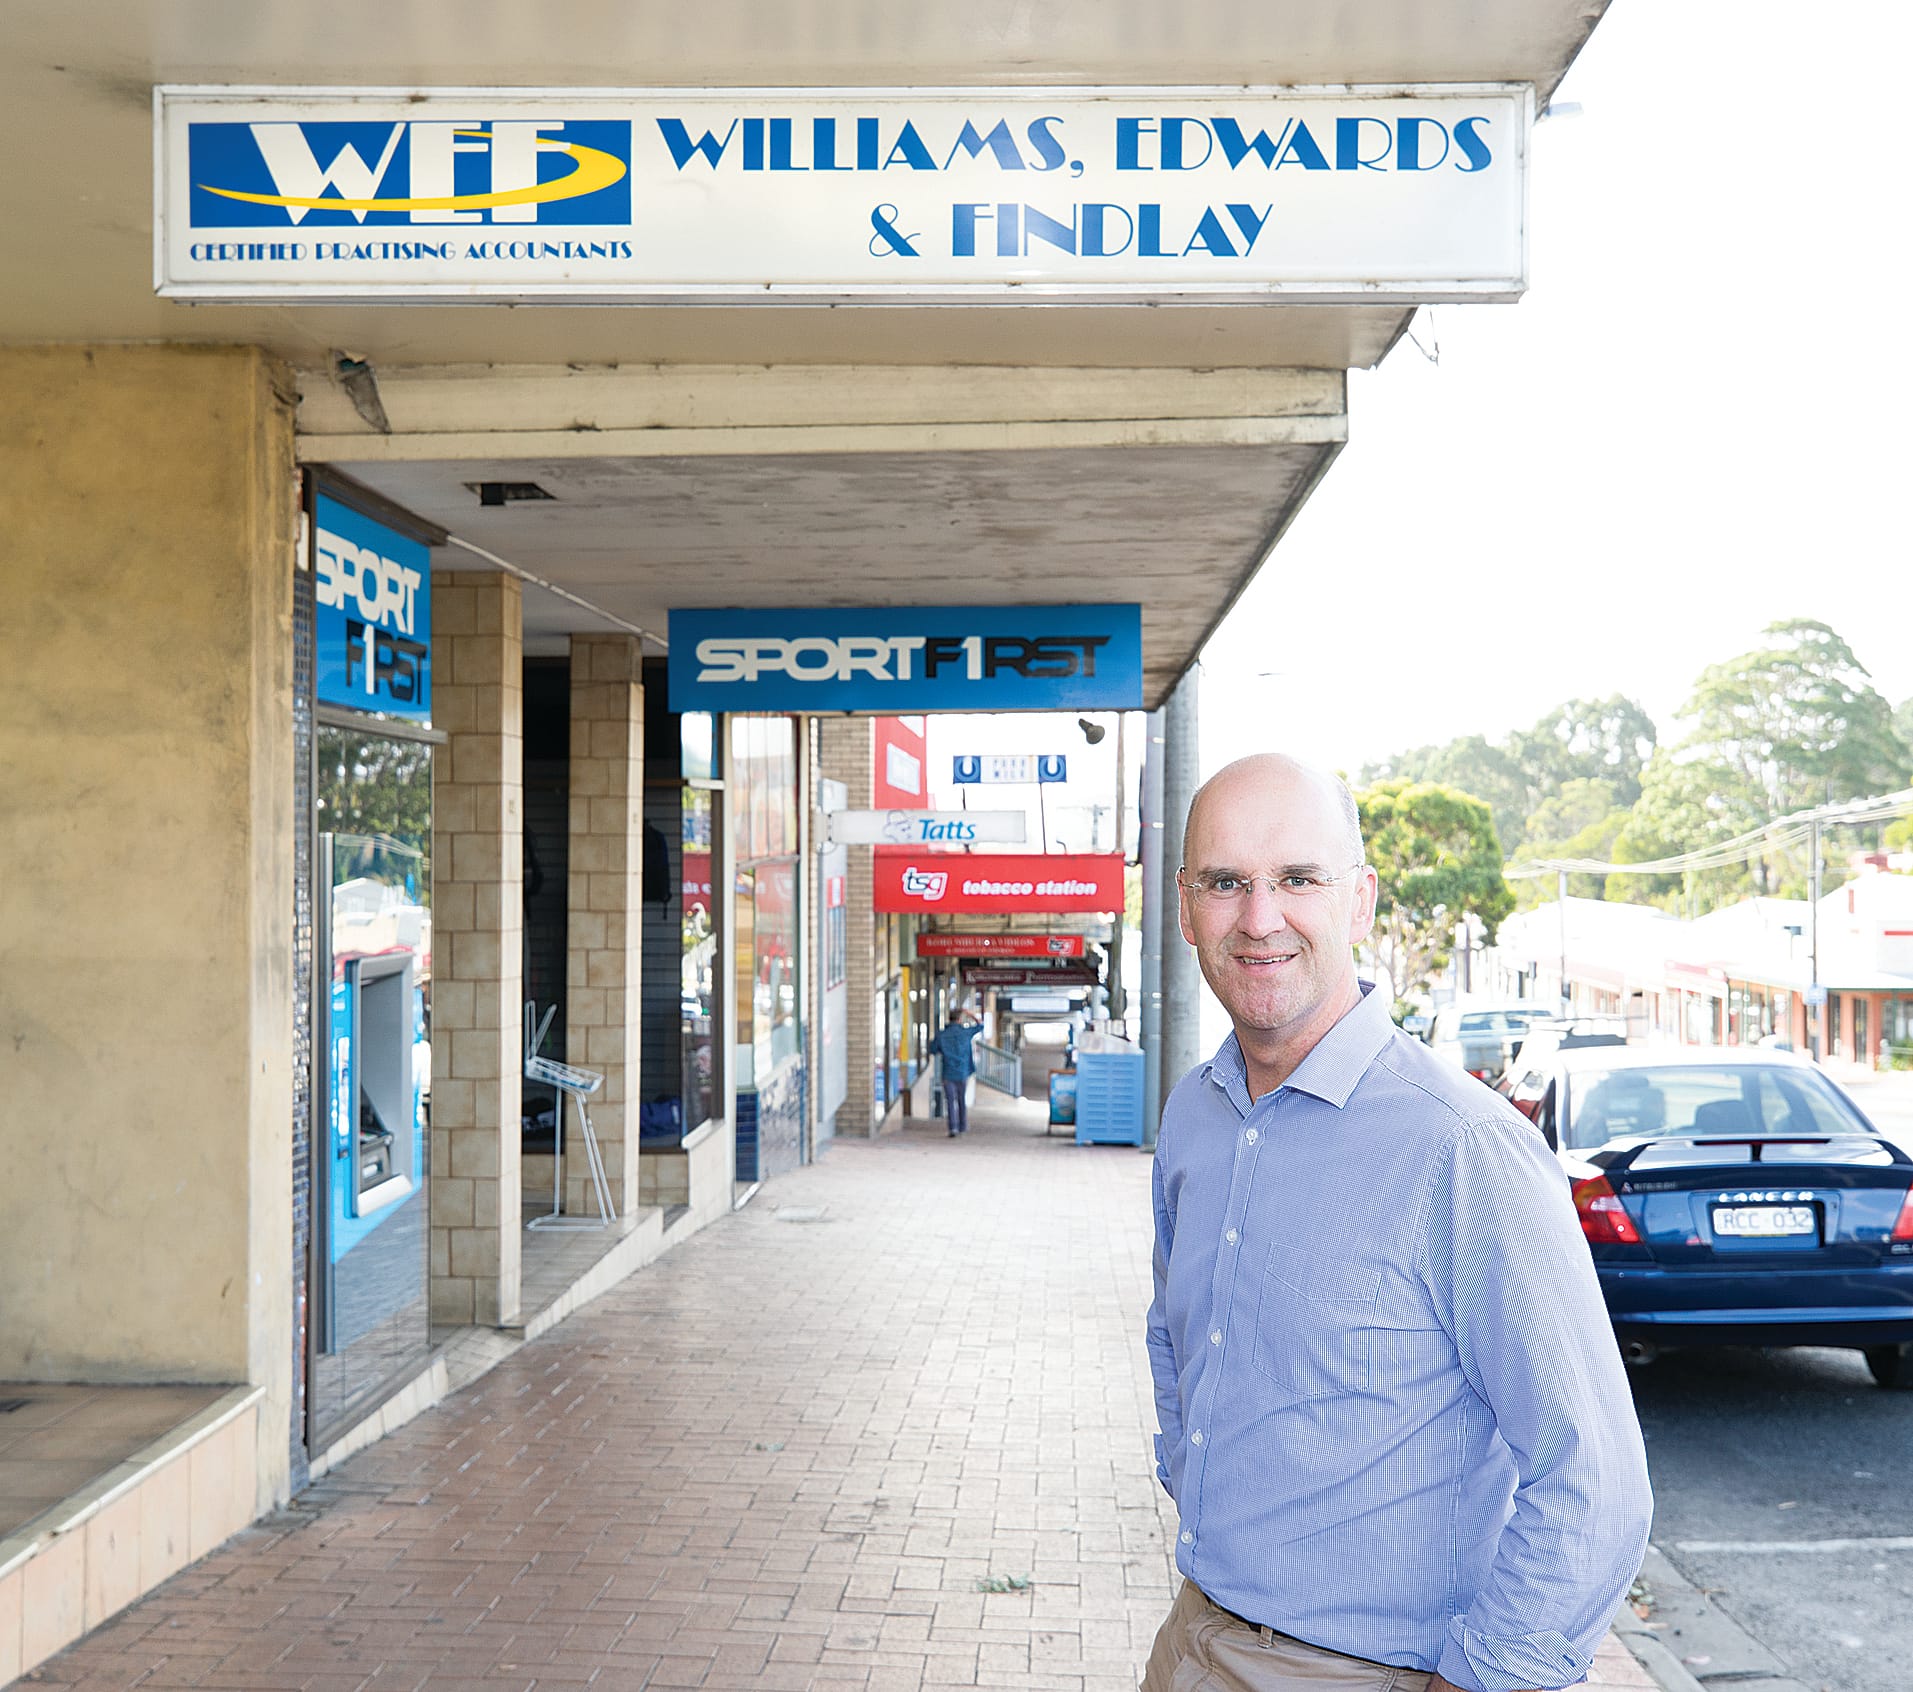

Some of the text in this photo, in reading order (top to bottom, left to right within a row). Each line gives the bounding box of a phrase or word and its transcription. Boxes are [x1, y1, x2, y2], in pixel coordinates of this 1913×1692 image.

[655, 116, 1493, 179] WILLIAMS, EDWARDS
[189, 240, 633, 262] CERTIFIED PRACTISING ACCOUNTANTS
[868, 203, 1274, 258] & FINDLAY
[316, 527, 421, 636] SPORT
[918, 818, 976, 840] Tatts
[902, 867, 1098, 900] tsg tobacco station
